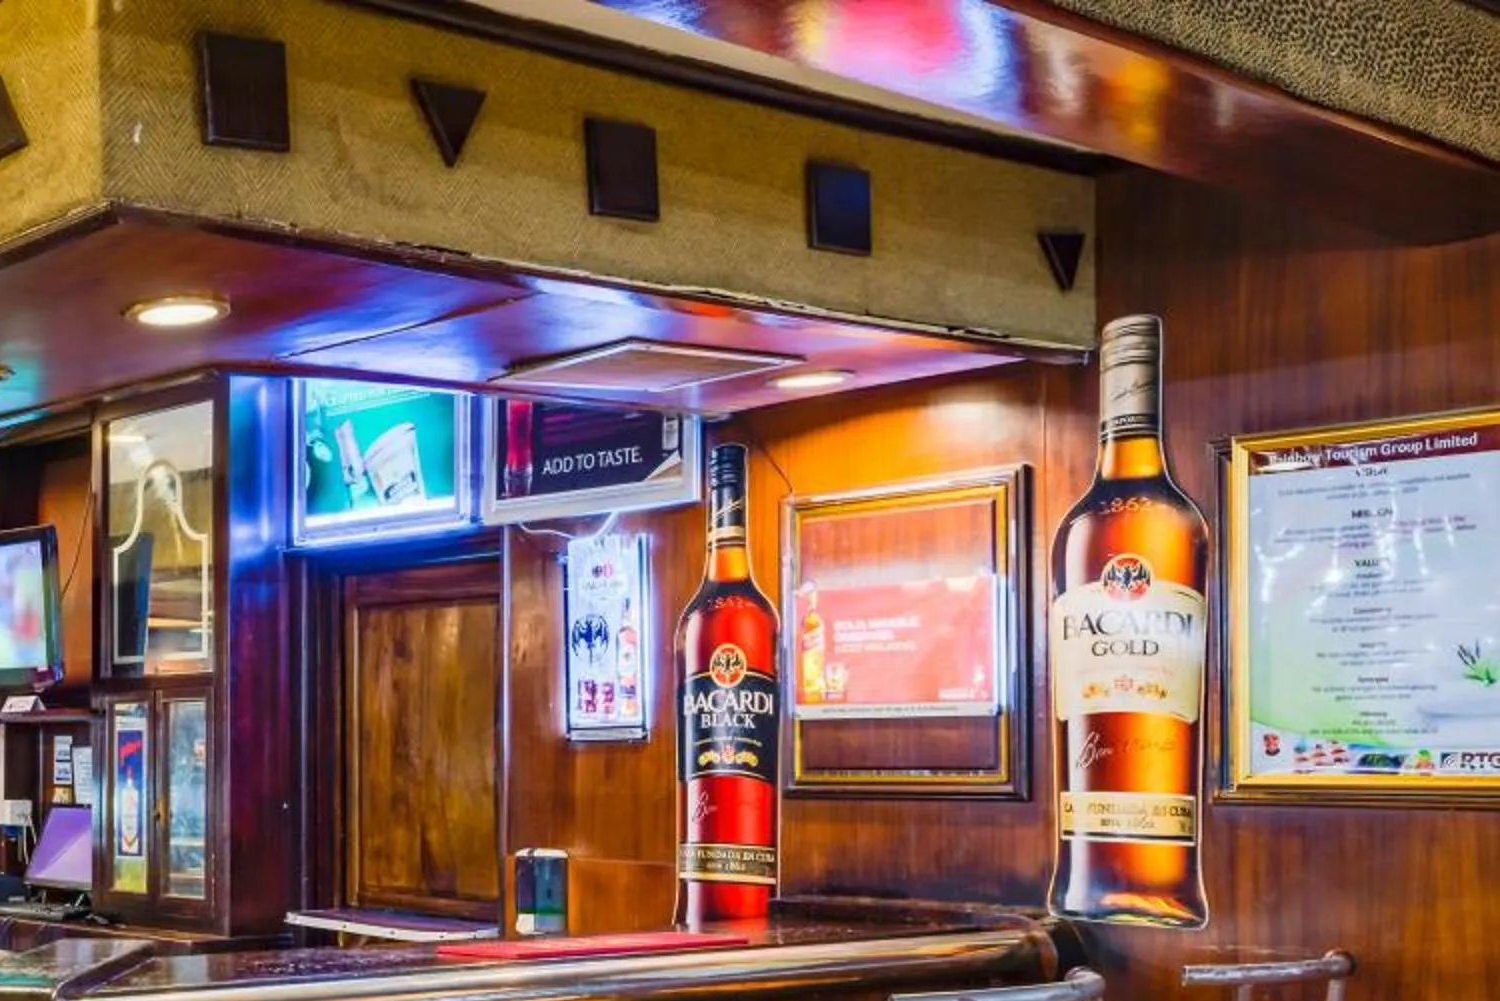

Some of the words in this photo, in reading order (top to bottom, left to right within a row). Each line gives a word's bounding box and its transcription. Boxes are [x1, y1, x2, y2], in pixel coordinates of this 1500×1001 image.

[542, 458, 573, 475] ADD
[576, 454, 595, 471] TO
[598, 445, 643, 467] TASTE.
[1325, 446, 1377, 461] Tourism
[1381, 441, 1423, 455] Group
[1425, 432, 1478, 451] Limited
[1063, 610, 1193, 640] BACARDI
[1091, 639, 1159, 657] GOLD
[684, 690, 773, 715] BACARDI
[701, 713, 756, 729] BLACK
